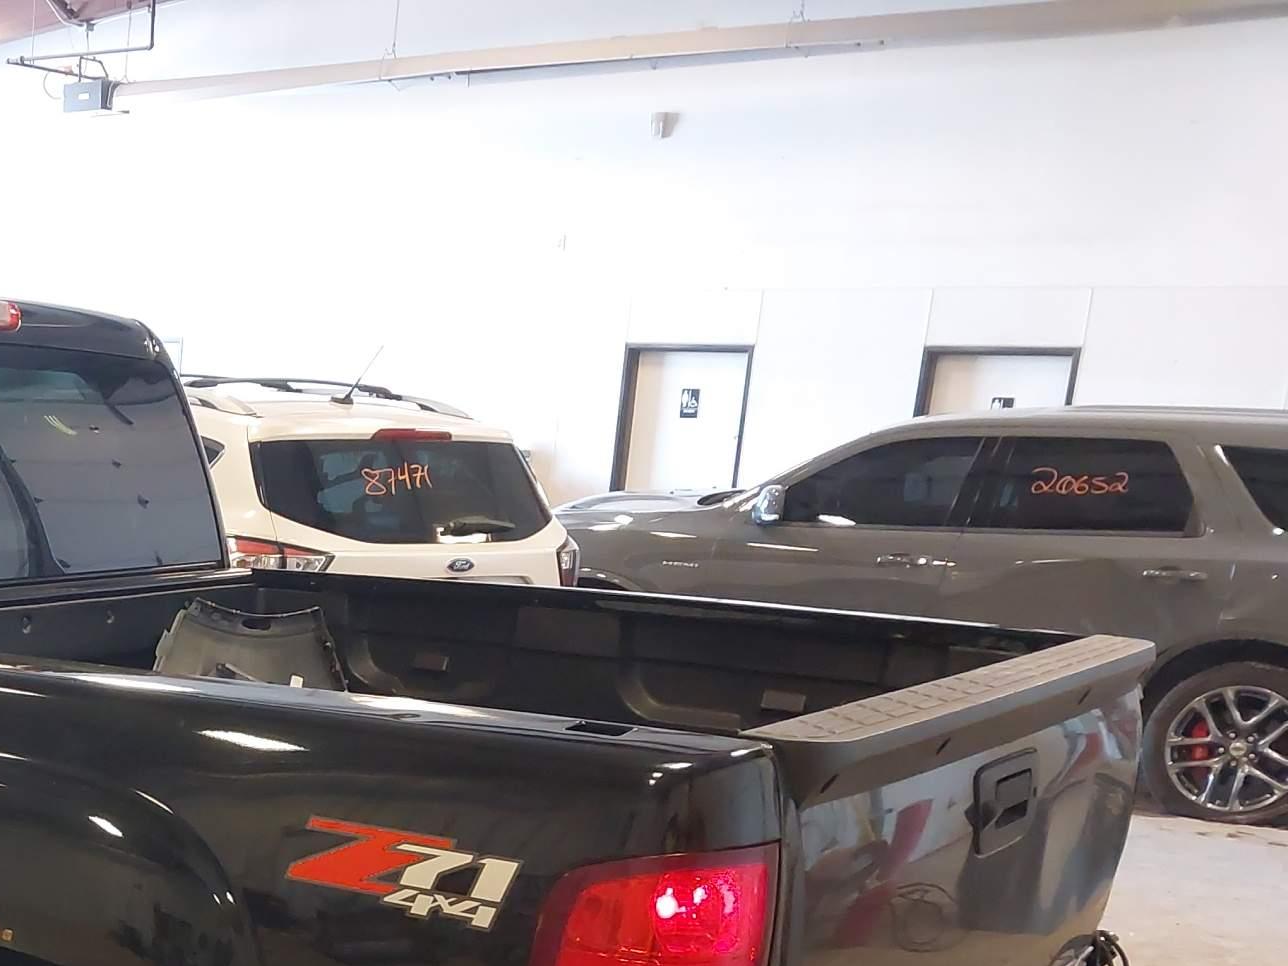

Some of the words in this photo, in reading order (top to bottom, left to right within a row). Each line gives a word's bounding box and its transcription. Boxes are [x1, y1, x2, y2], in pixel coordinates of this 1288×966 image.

[361, 461, 432, 496] 87471
[1031, 466, 1129, 495] 20652
[285, 815, 524, 903] Z71
